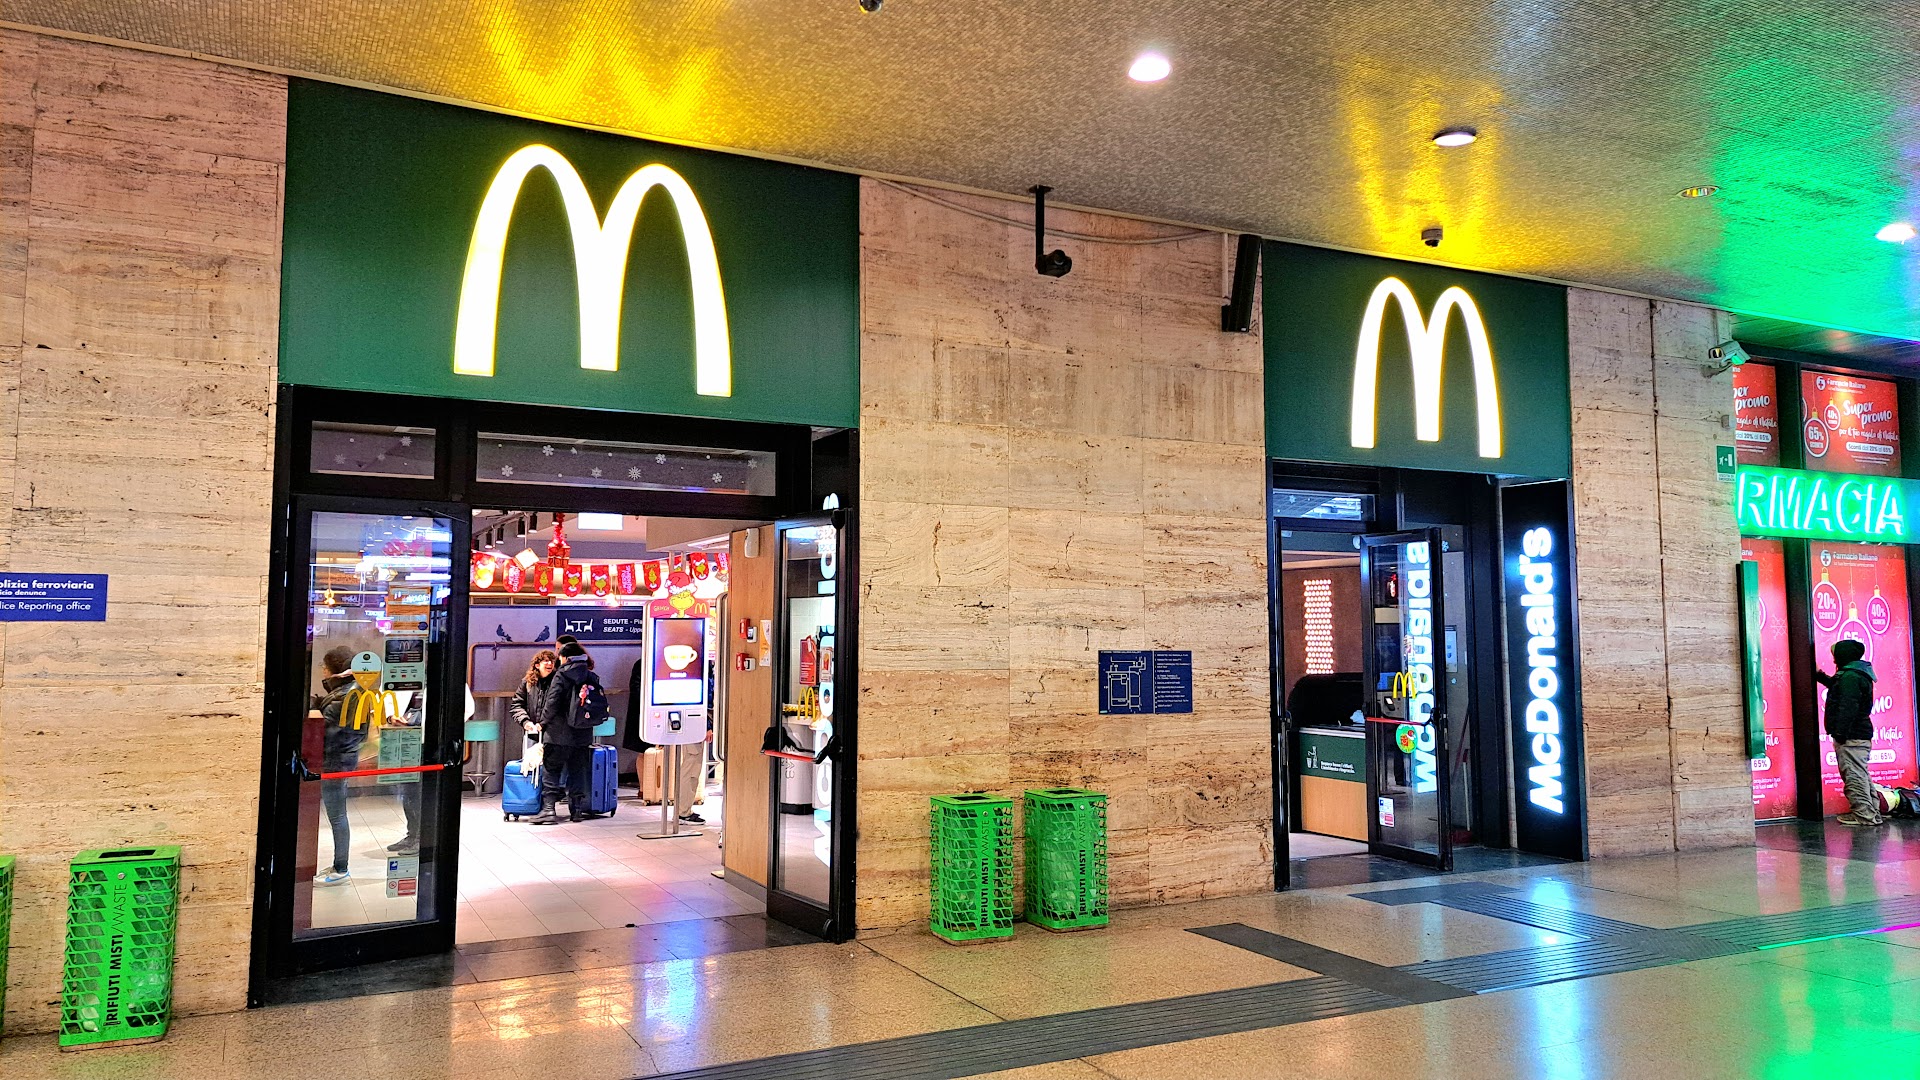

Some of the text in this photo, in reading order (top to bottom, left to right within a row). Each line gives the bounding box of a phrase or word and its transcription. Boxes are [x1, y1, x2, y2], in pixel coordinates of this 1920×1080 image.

[1735, 396, 1770, 415] promo
[1843, 400, 1874, 418] Super
[1861, 411, 1892, 429] promo
[1808, 426, 1824, 440] 65%
[32, 580, 94, 589] ferroviaria
[19, 602, 63, 612] Reporting
[66, 601, 91, 610] office
[1817, 592, 1836, 610] 20%
[1872, 604, 1886, 617] 40%
[1520, 526, 1565, 814] McDonald's
[1880, 726, 1903, 746] Natale
[1754, 759, 1767, 768] 65%
[1881, 752, 1893, 760] 65%
[980, 889, 989, 927] RIFIUTI
[106, 975, 121, 1021] RIFIUTI
